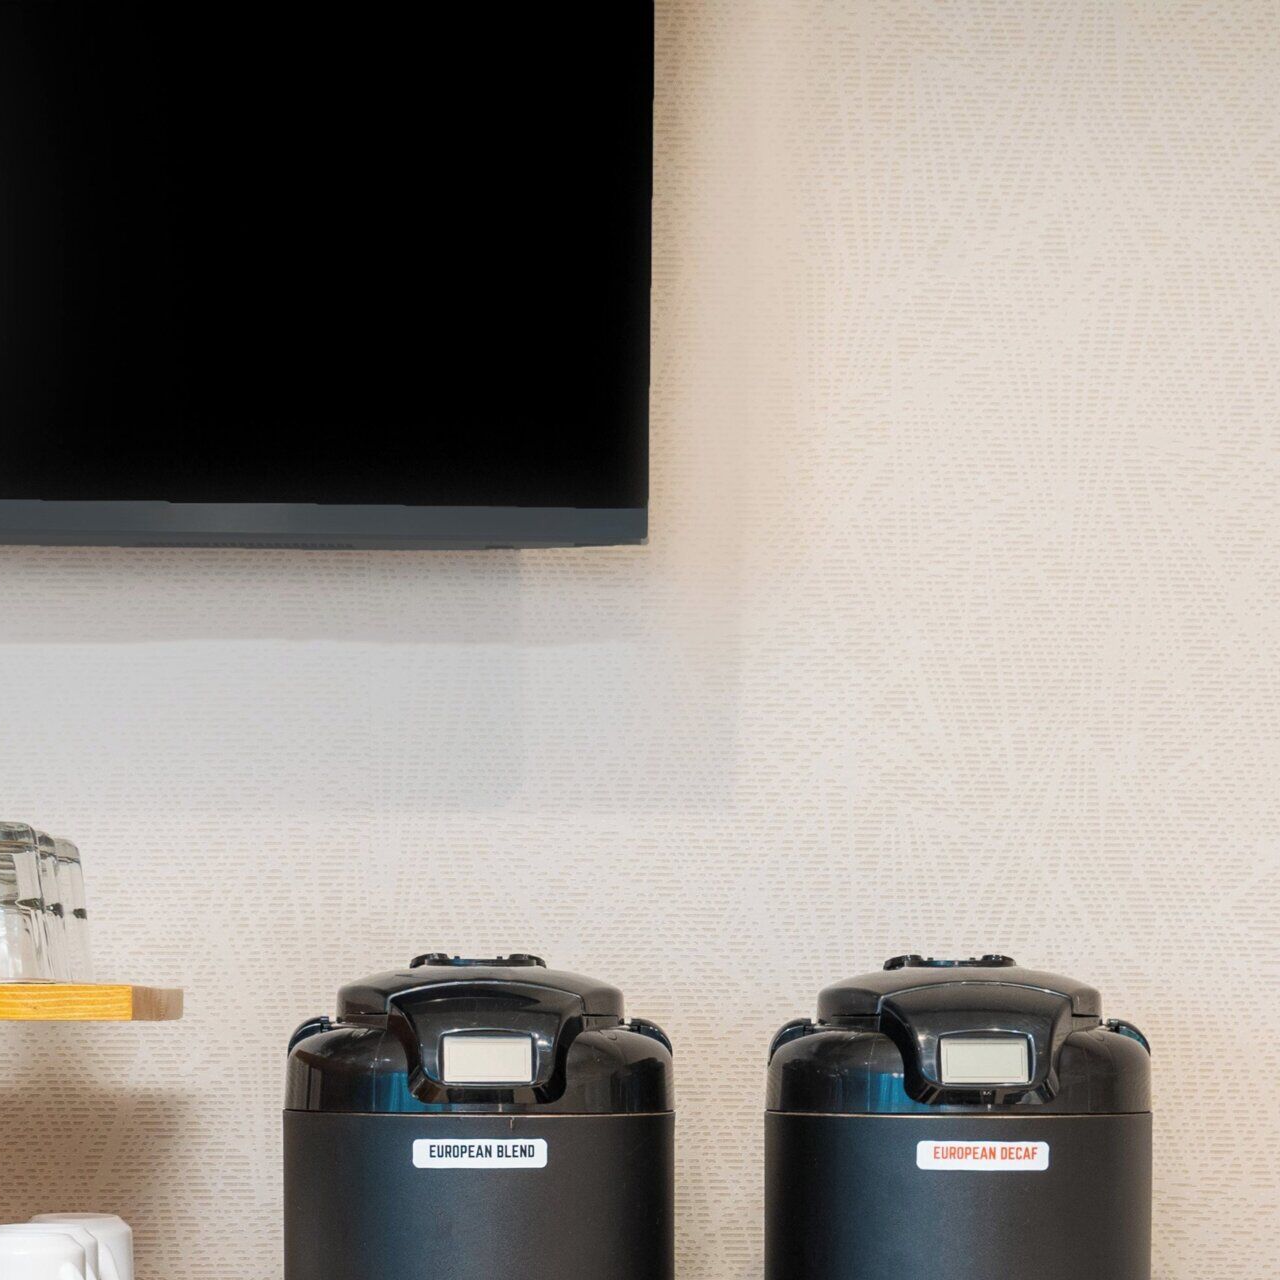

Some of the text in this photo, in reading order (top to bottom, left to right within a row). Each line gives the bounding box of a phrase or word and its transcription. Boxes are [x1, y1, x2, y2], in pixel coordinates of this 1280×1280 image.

[429, 1144, 535, 1158] EUROPEAN BLEND
[933, 1146, 1038, 1160] EUROPEAN DECAF
